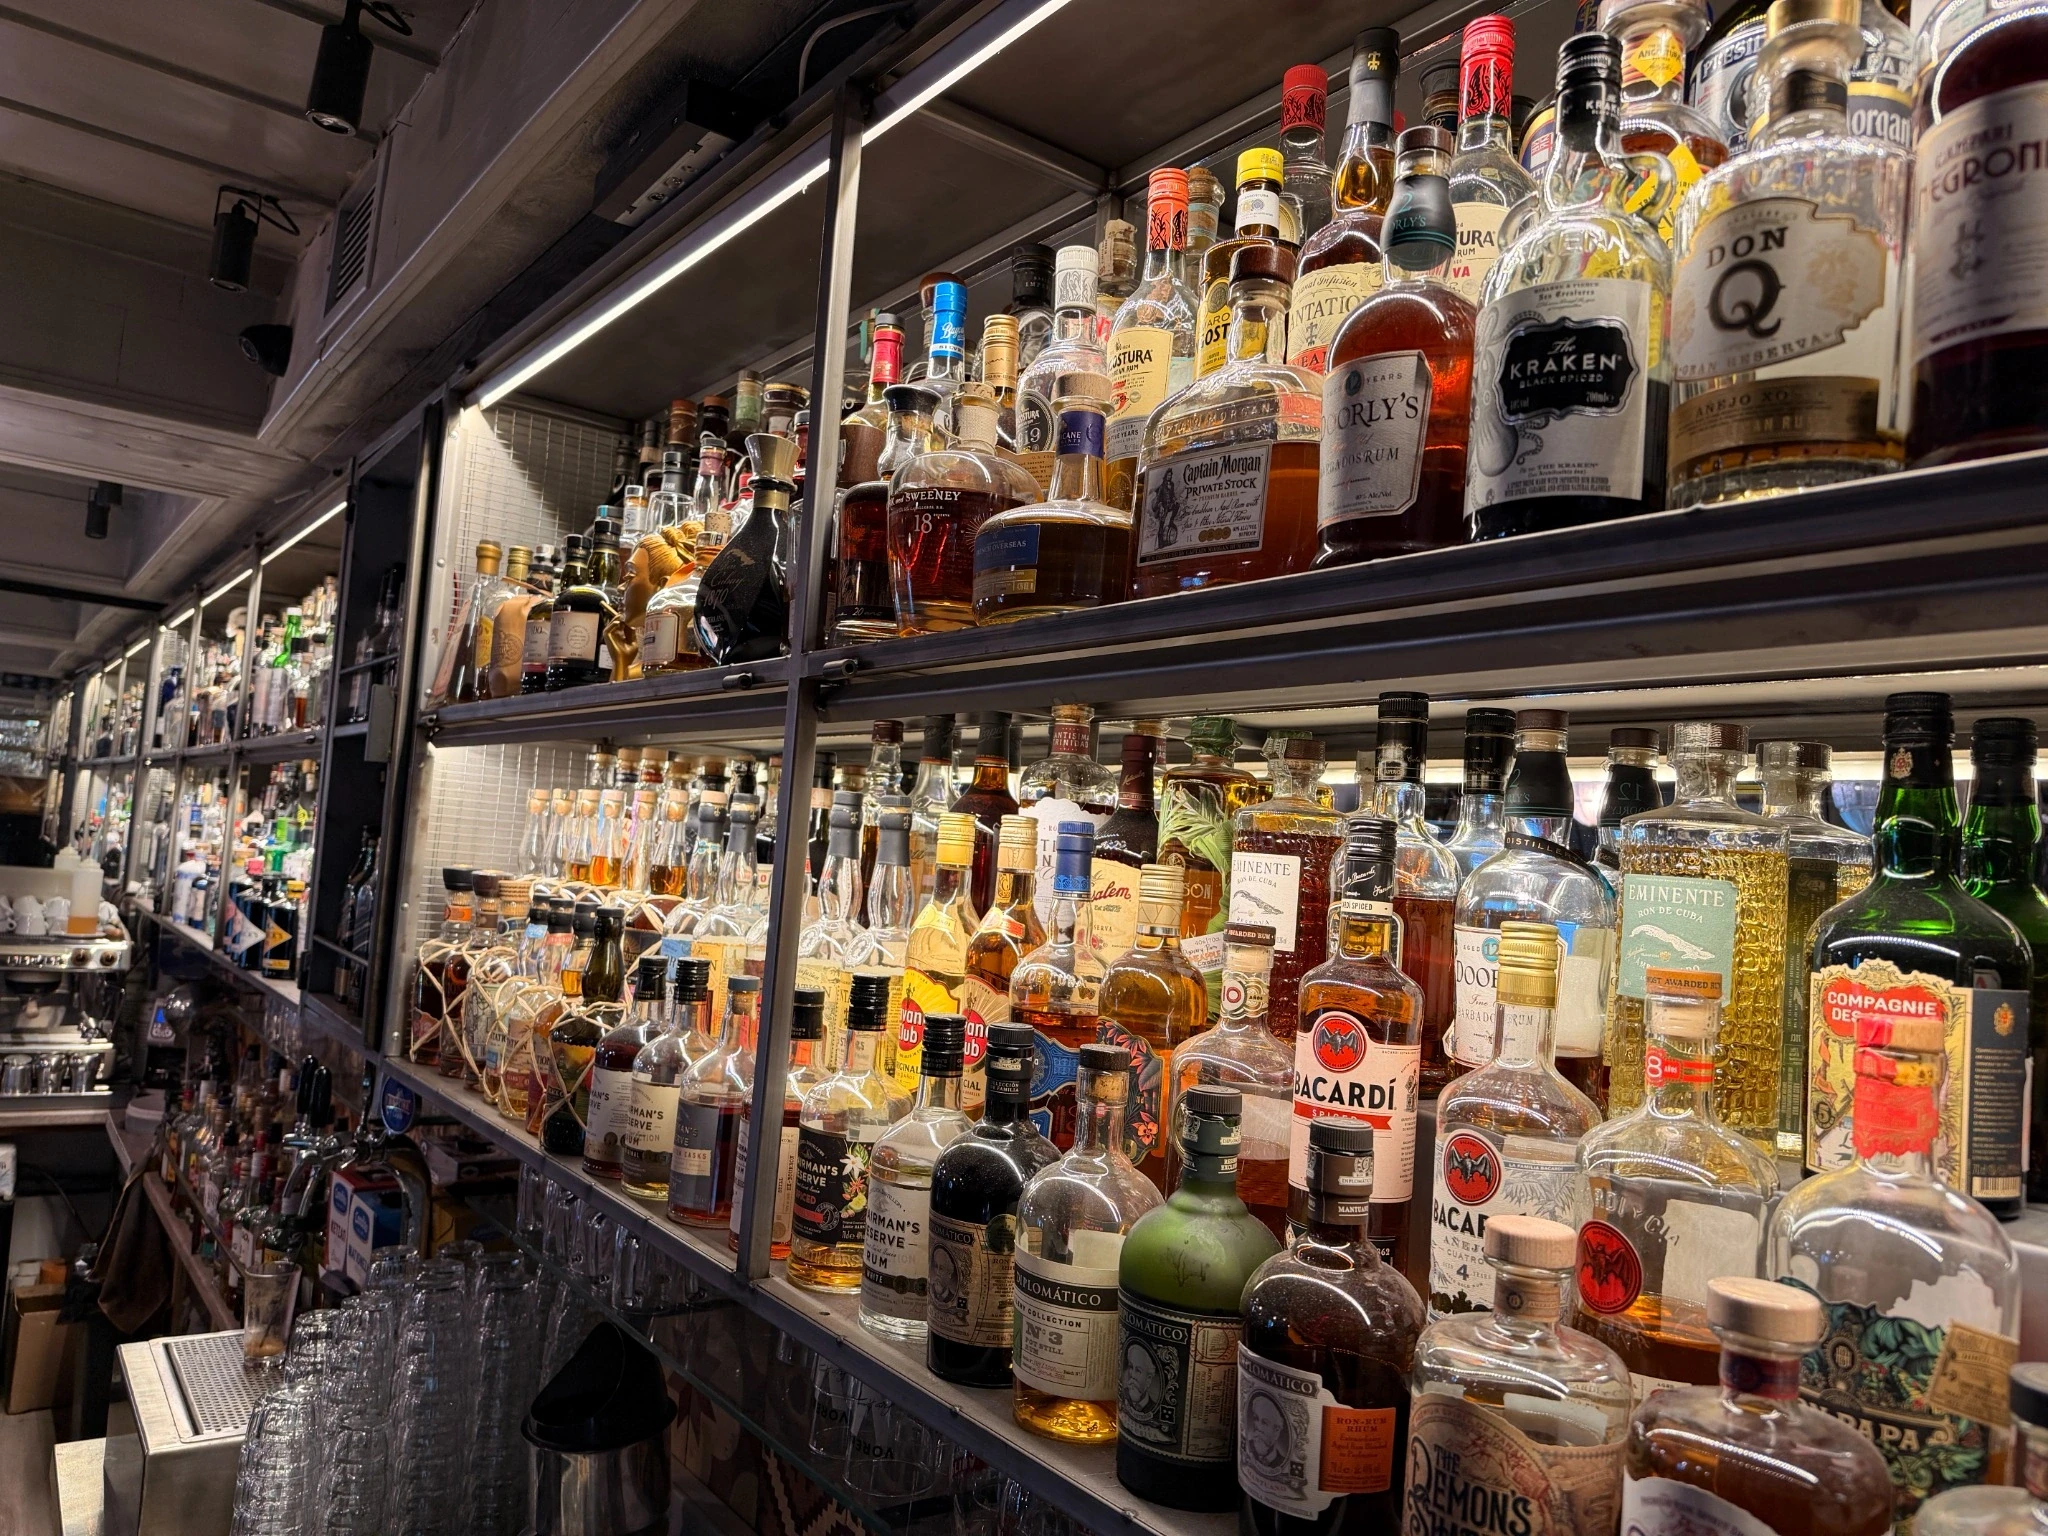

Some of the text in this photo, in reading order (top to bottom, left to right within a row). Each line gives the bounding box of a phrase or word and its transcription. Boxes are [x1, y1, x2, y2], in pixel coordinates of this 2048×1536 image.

[1457, 229, 1496, 249] URA
[1705, 226, 1789, 270] DON
[1457, 247, 1476, 257] RUM
[1452, 266, 1471, 278] VA
[1706, 258, 1787, 340] Q
[1548, 336, 1577, 356] The
[1727, 333, 1822, 368] RESERVA
[1510, 353, 1617, 381] KRAKEN
[1366, 373, 1403, 385] YEARS
[1519, 373, 1604, 389] BLACK SPICED
[1363, 448, 1400, 465] RUM
[1183, 454, 1261, 485] Captain Morgan
[904, 488, 962, 501] SWEENEY
[1181, 477, 1258, 500] PRIVATE STOCK
[914, 512, 933, 534] 18
[1232, 859, 1292, 877] EMINENTE
[1258, 876, 1278, 889] CUBA
[1628, 883, 1726, 908] EMINENTE
[1351, 901, 1374, 911] SPICED
[1637, 906, 1704, 924] RON DE CUBA
[1483, 943, 1499, 957] 12
[1664, 978, 1708, 990] AWARDED
[1468, 993, 1489, 1008] Fine
[1827, 991, 1938, 1016] COMPAGNIE
[1831, 1006, 1861, 1023] DES
[1646, 1055, 1662, 1078] 8
[1294, 1071, 1397, 1111] BACARDÍ
[866, 1251, 888, 1270] RUM
[1446, 1248, 1485, 1266] CUATRO
[1456, 1263, 1470, 1281] 4
[1015, 1270, 1102, 1307] DIPLOMÁTICO
[1027, 1307, 1082, 1329] COLLECTION
[1048, 1330, 1064, 1346] 3
[1038, 1341, 1065, 1356] STILL
[1434, 1443, 1461, 1476] THE
